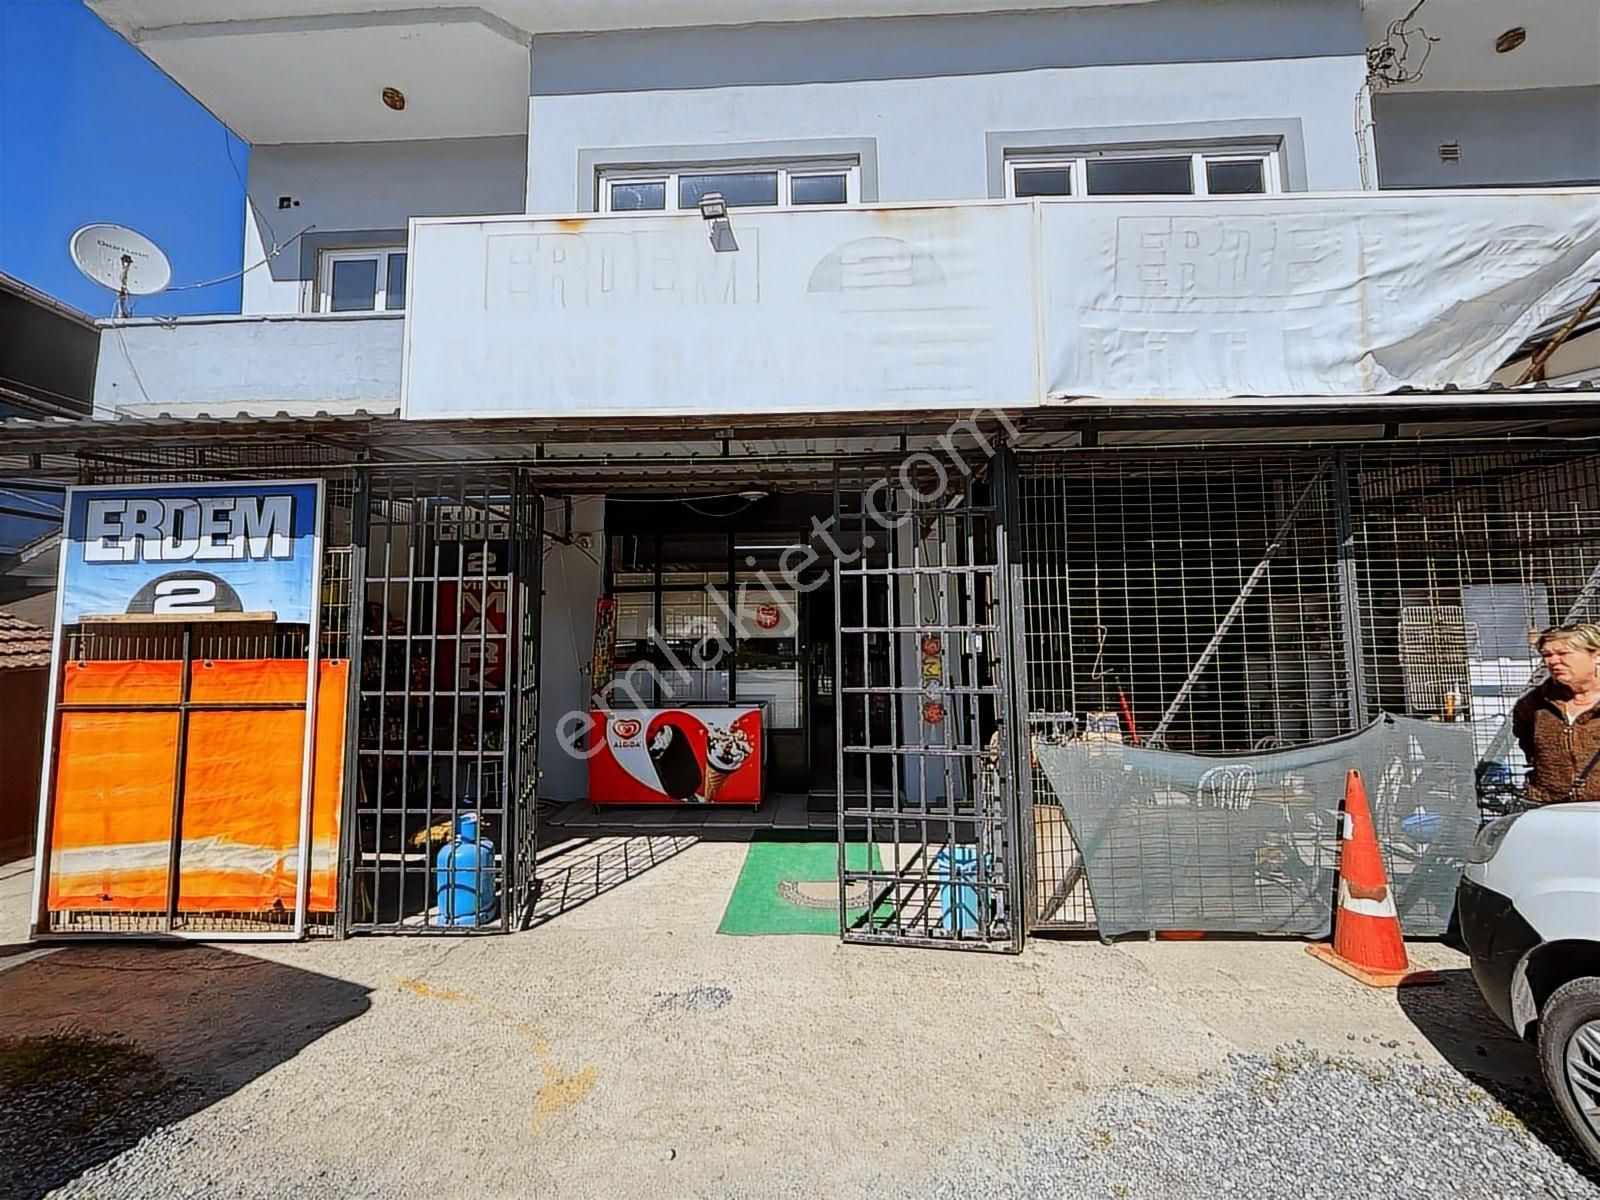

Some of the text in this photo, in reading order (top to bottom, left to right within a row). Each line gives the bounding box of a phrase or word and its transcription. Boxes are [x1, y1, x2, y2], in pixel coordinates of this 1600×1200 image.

[85, 495, 293, 562] ERDEM
[467, 552, 497, 573] 2
[154, 579, 216, 614] 2
